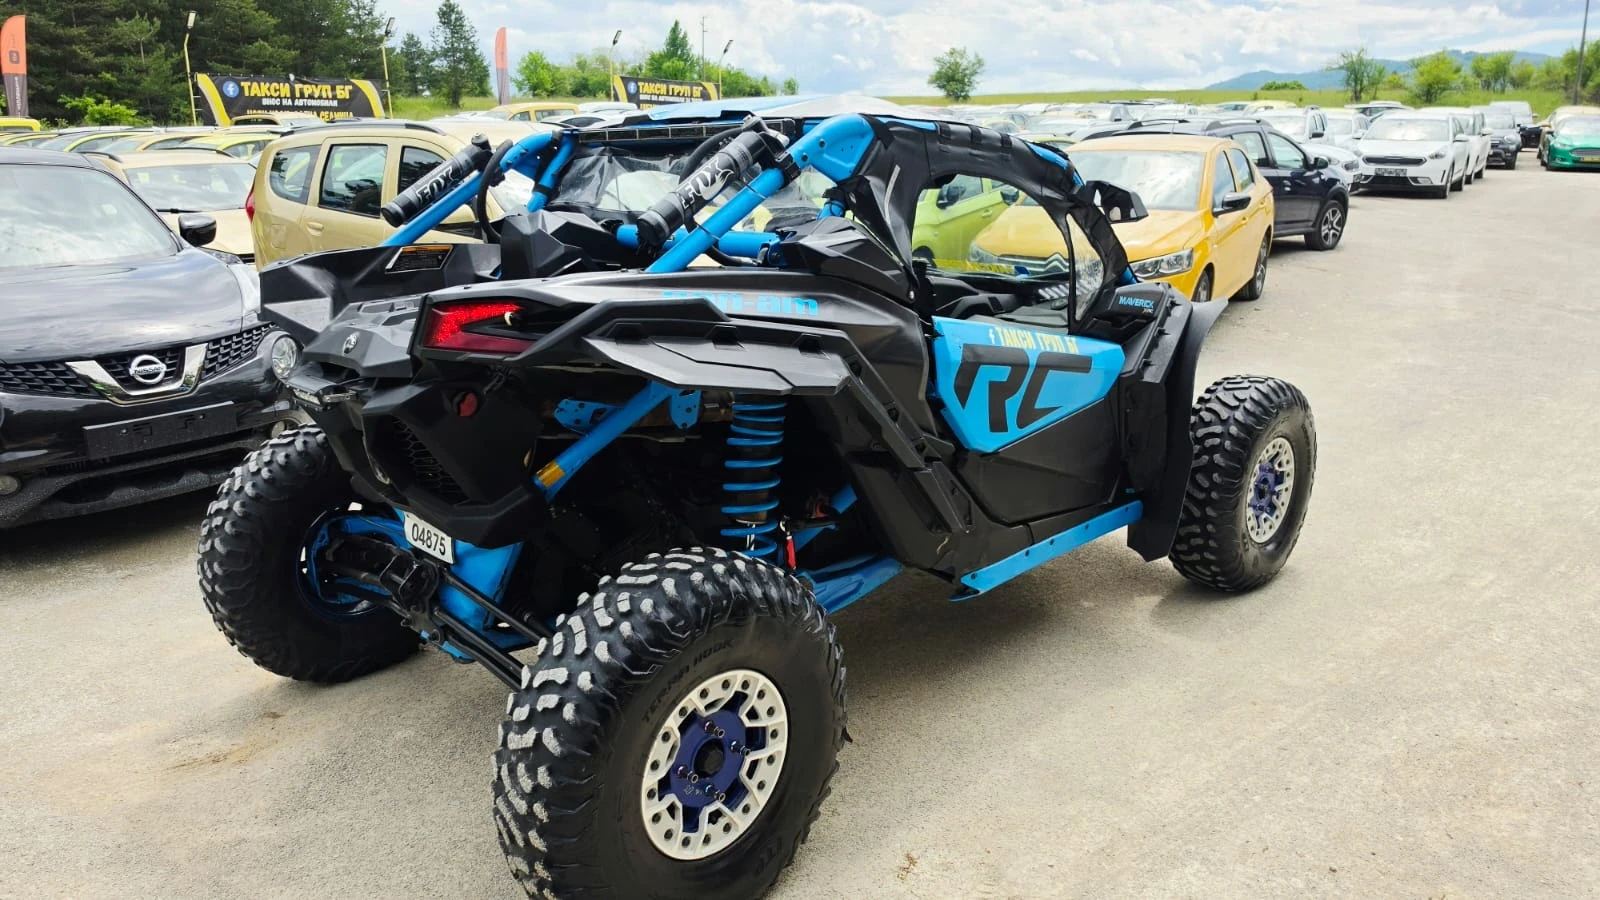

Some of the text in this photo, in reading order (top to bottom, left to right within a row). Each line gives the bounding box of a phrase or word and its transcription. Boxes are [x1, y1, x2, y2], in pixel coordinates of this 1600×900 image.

[240, 81, 353, 99] ТАКСИ ГРУП БГ
[639, 82, 702, 97] ТАКСИ ГРУП БГ
[415, 166, 455, 201] FOX
[680, 156, 733, 209] FOX
[1118, 295, 1154, 309] MAVERICK
[995, 327, 1036, 350] ТАКСИ
[1036, 332, 1066, 353] ГРУП
[134, 366, 164, 375] NISSAN
[953, 343, 1093, 433] RC
[411, 523, 446, 556] 04875
